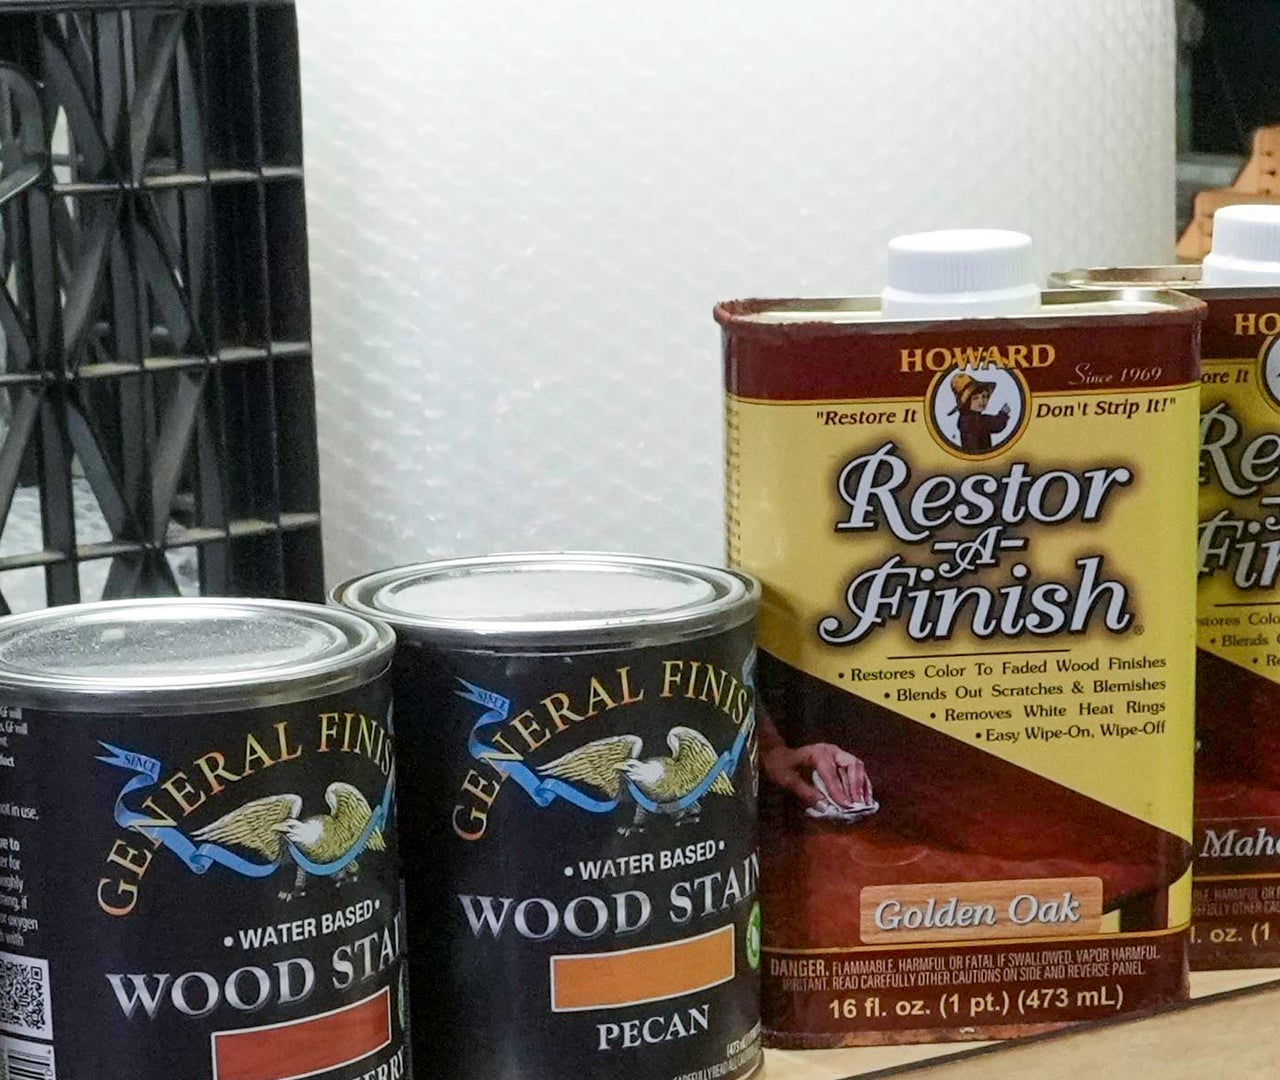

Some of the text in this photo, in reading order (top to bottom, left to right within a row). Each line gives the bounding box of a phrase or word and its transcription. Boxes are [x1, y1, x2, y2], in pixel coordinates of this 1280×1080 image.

[899, 344, 1056, 372] HOWARD
[1068, 363, 1162, 385] Since 1969
[1237, 369, 1249, 383] It
[816, 397, 1176, 426] "Restore It Don't Strip It!"
[835, 441, 1131, 543] Restor
[819, 555, 1132, 645] Finish
[1221, 633, 1269, 647] Blends
[851, 656, 1166, 682] Restores Color To Faded Wood Finishes
[897, 678, 1166, 703] Blends Out Scratches & Blemishes
[944, 700, 1166, 722] Removes White Heat Rings
[985, 720, 1166, 744] Easy Wipe-On, Wipe-Off
[452, 660, 757, 841] GENERAL FINIS
[97, 721, 302, 917] GENERAL
[317, 712, 393, 777] FINIS
[579, 840, 716, 880] WATER BASED
[459, 850, 761, 941] WOOD STAIN
[239, 900, 372, 950] WATER BASED
[873, 892, 1081, 932] Golden Oak
[1210, 925, 1243, 942] oz.
[1250, 921, 1270, 946] (1
[105, 911, 403, 1021] WOOD STAI
[771, 958, 829, 976] DANGER.
[898, 957, 945, 971] HARMFUL
[965, 954, 993, 968] FATAL
[1076, 948, 1108, 963] VAPOR
[832, 975, 859, 990] READ
[860, 973, 916, 989] CAREFULLY
[917, 971, 950, 986] OTHER
[952, 969, 1001, 984] CAUTIONS
[1003, 967, 1017, 981] ON
[1021, 967, 1041, 981] SIDE
[1044, 965, 1066, 979] AND
[1067, 963, 1109, 978] REVERSE
[829, 984, 1124, 1019] 16 fl. oz. (1 pt.) (473 mL)
[596, 1004, 711, 1051] PECAN
